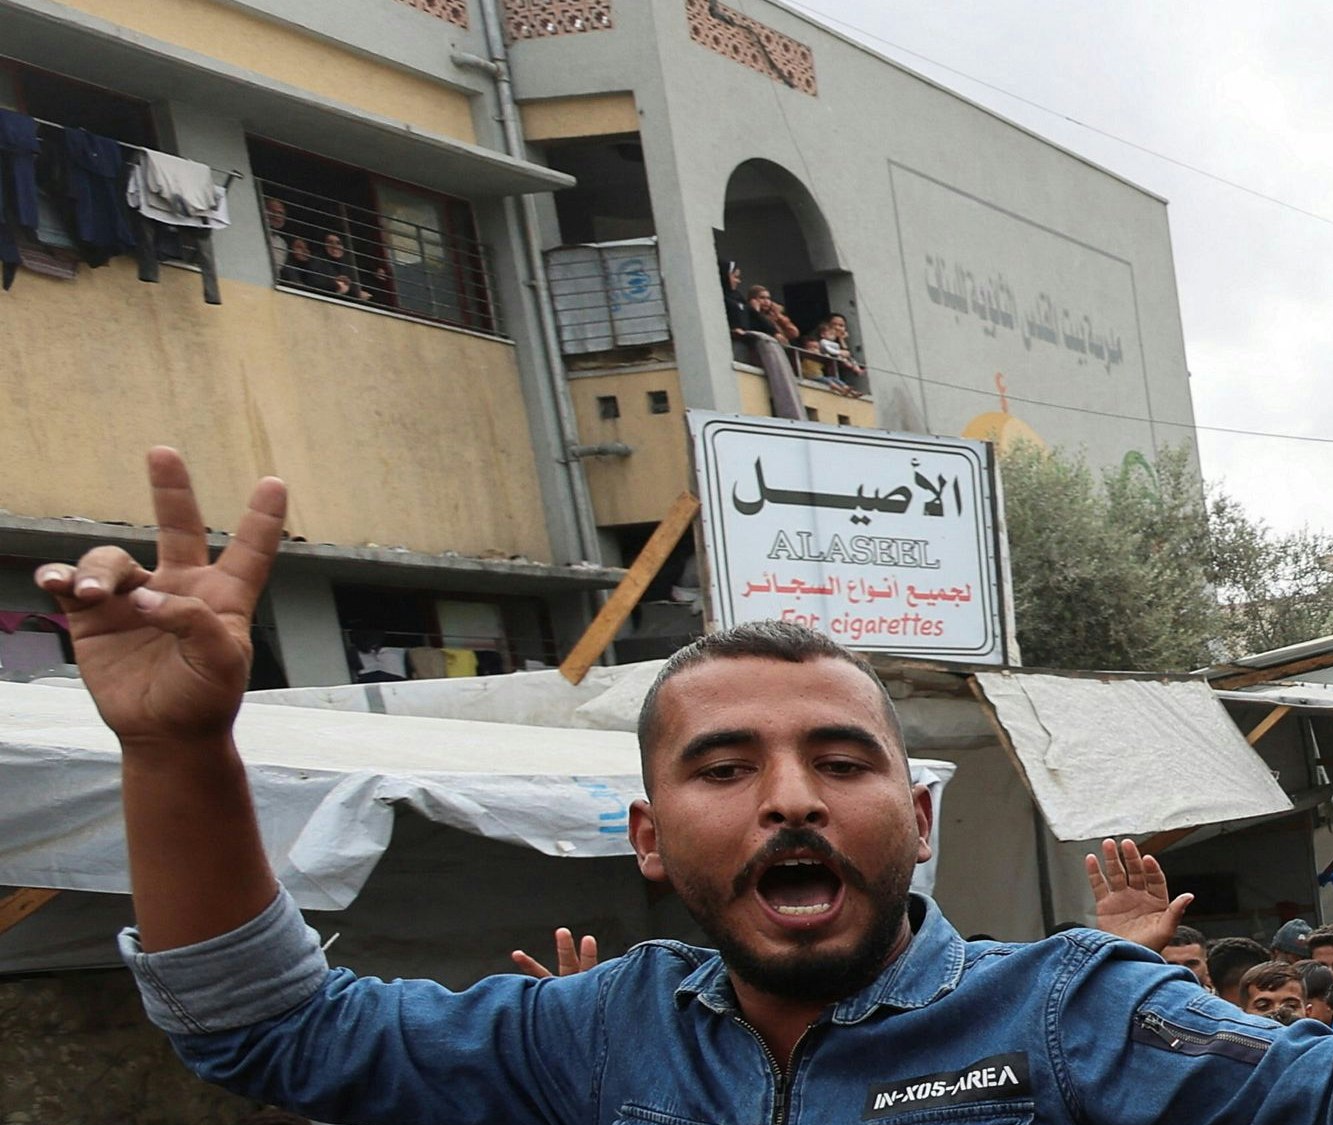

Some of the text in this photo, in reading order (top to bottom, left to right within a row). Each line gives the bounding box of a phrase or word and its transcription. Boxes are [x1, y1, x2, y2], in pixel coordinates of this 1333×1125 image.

[732, 456, 963, 526] الأصيل
[767, 529, 941, 569] ALASEEL
[906, 583, 972, 608] لجميع
[830, 611, 944, 641] cigarettes
